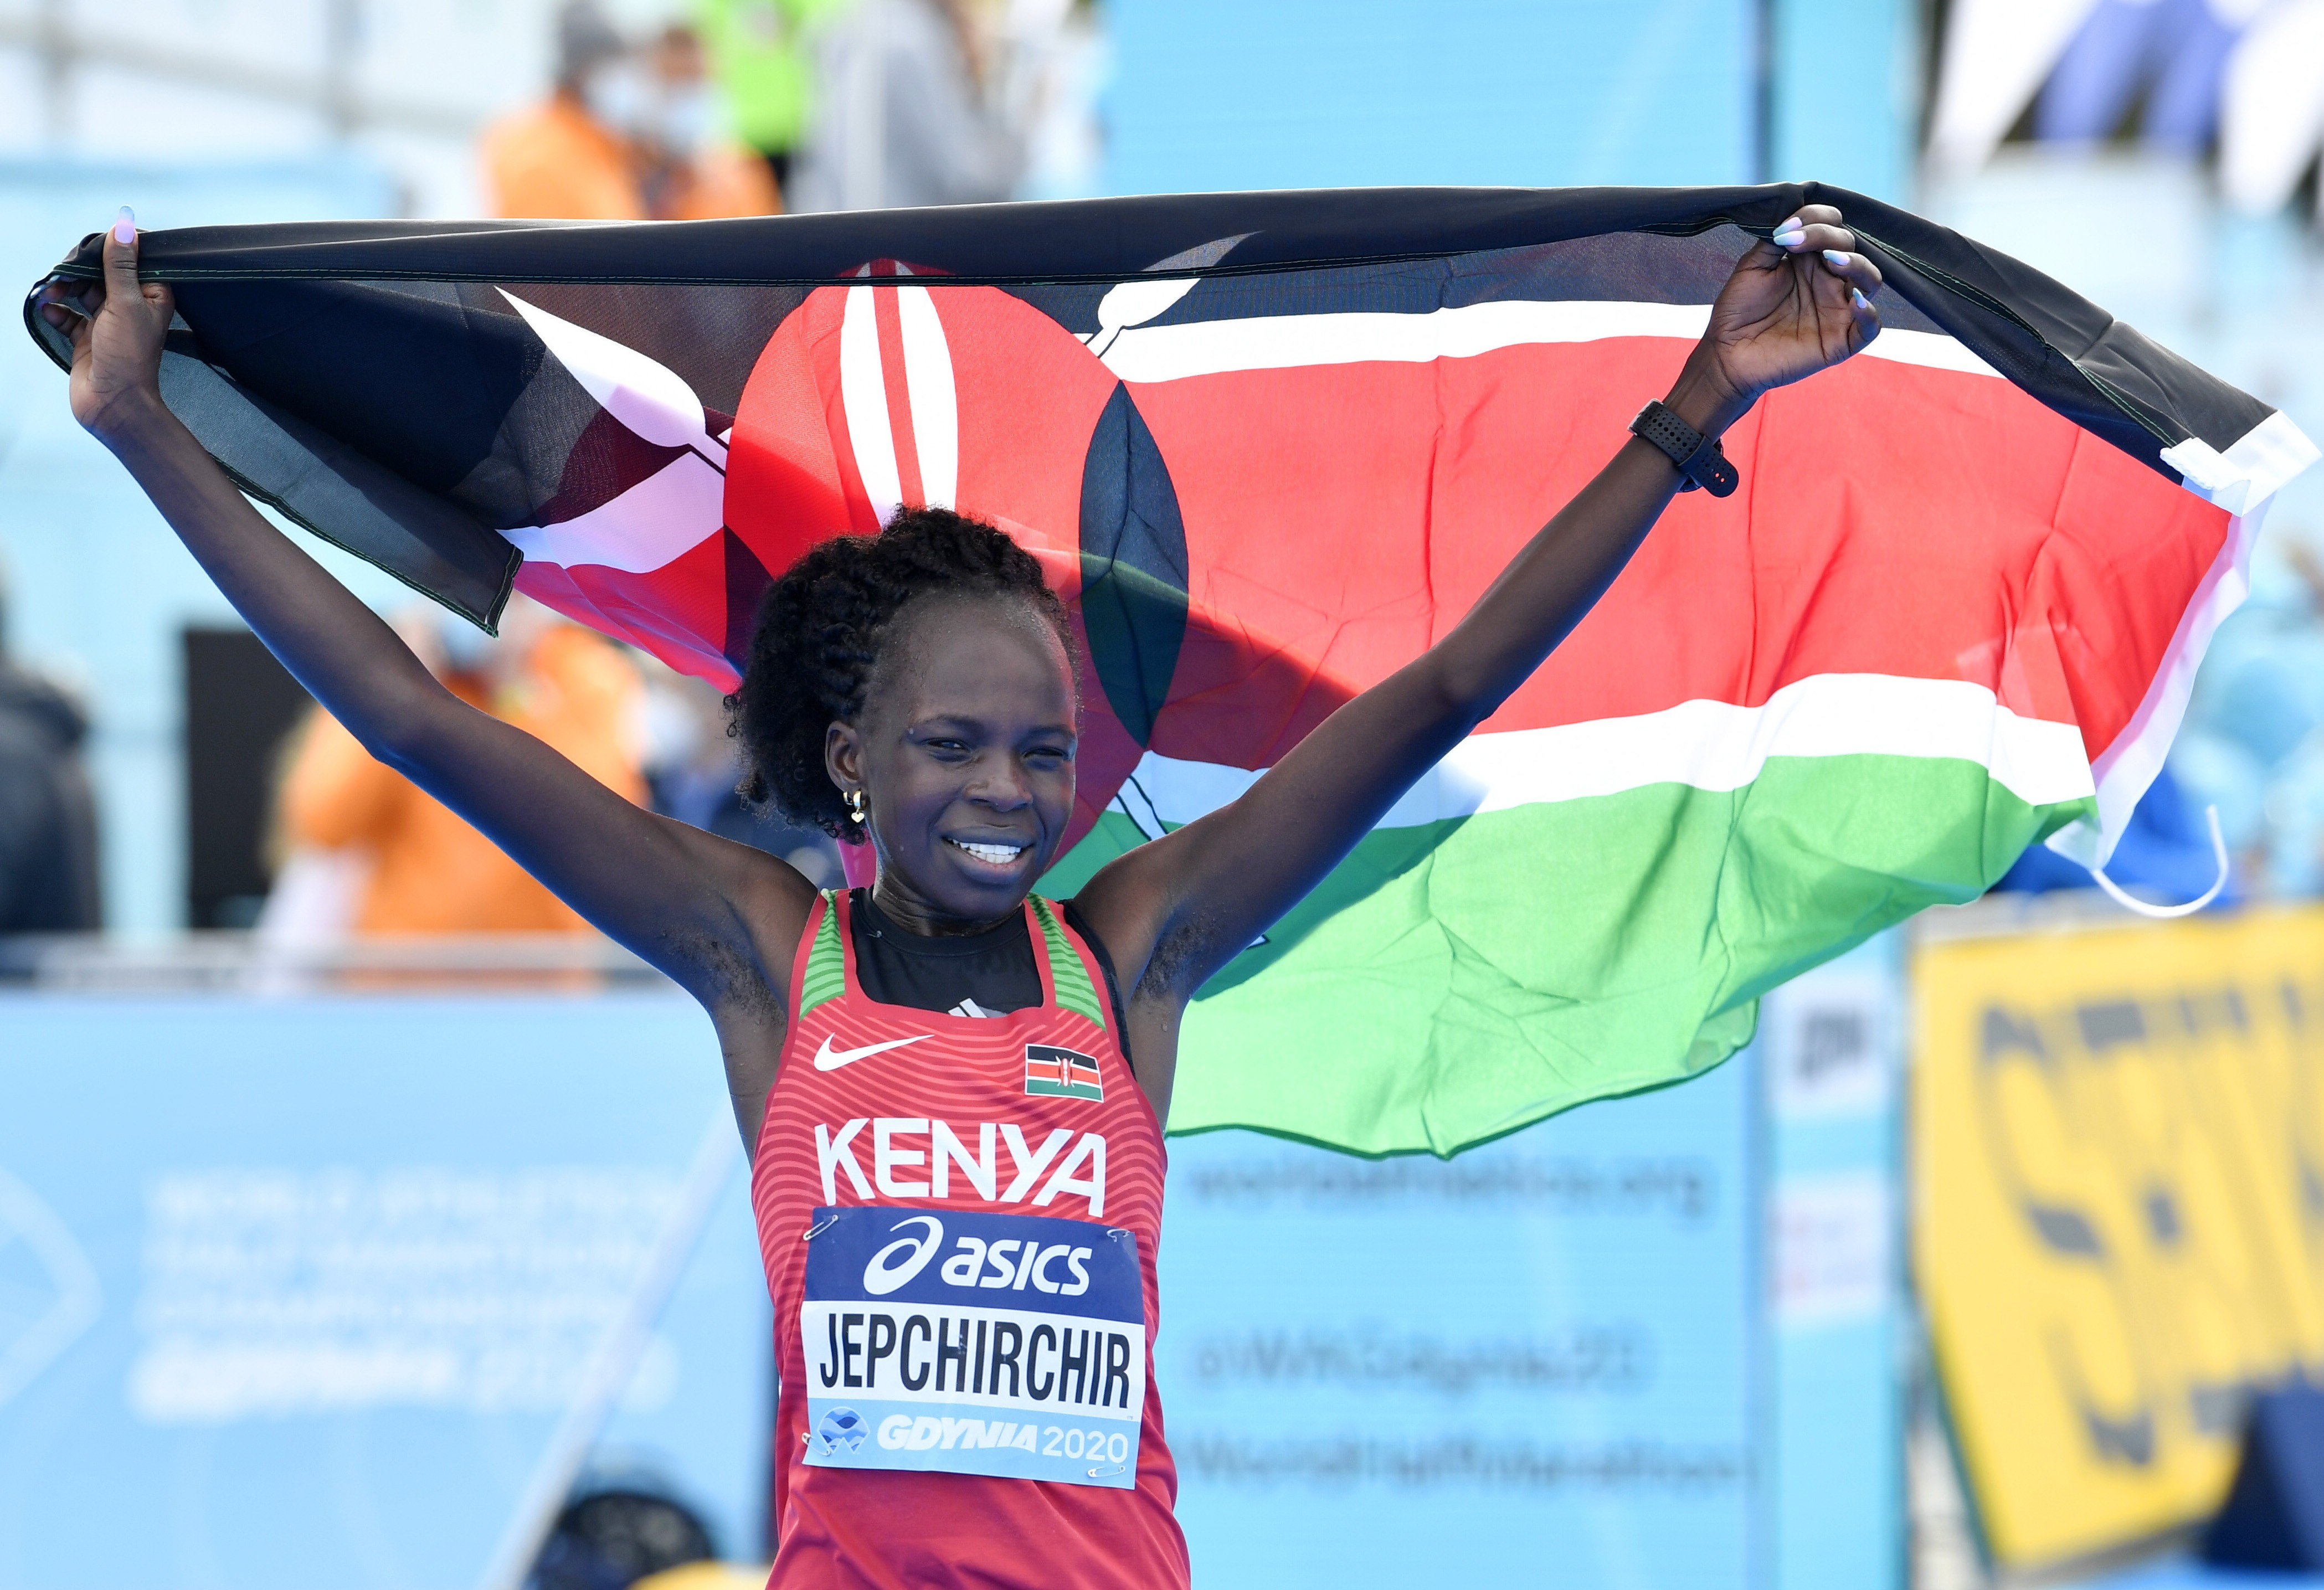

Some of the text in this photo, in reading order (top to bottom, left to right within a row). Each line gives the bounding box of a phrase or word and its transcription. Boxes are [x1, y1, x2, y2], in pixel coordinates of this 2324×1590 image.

[814, 1118, 1107, 1217] KENYA
[940, 1236, 1093, 1296] asics
[820, 1313, 1130, 1409] JEPCHIRCHIR
[877, 1414, 1128, 1464] GDYNIA 2020
